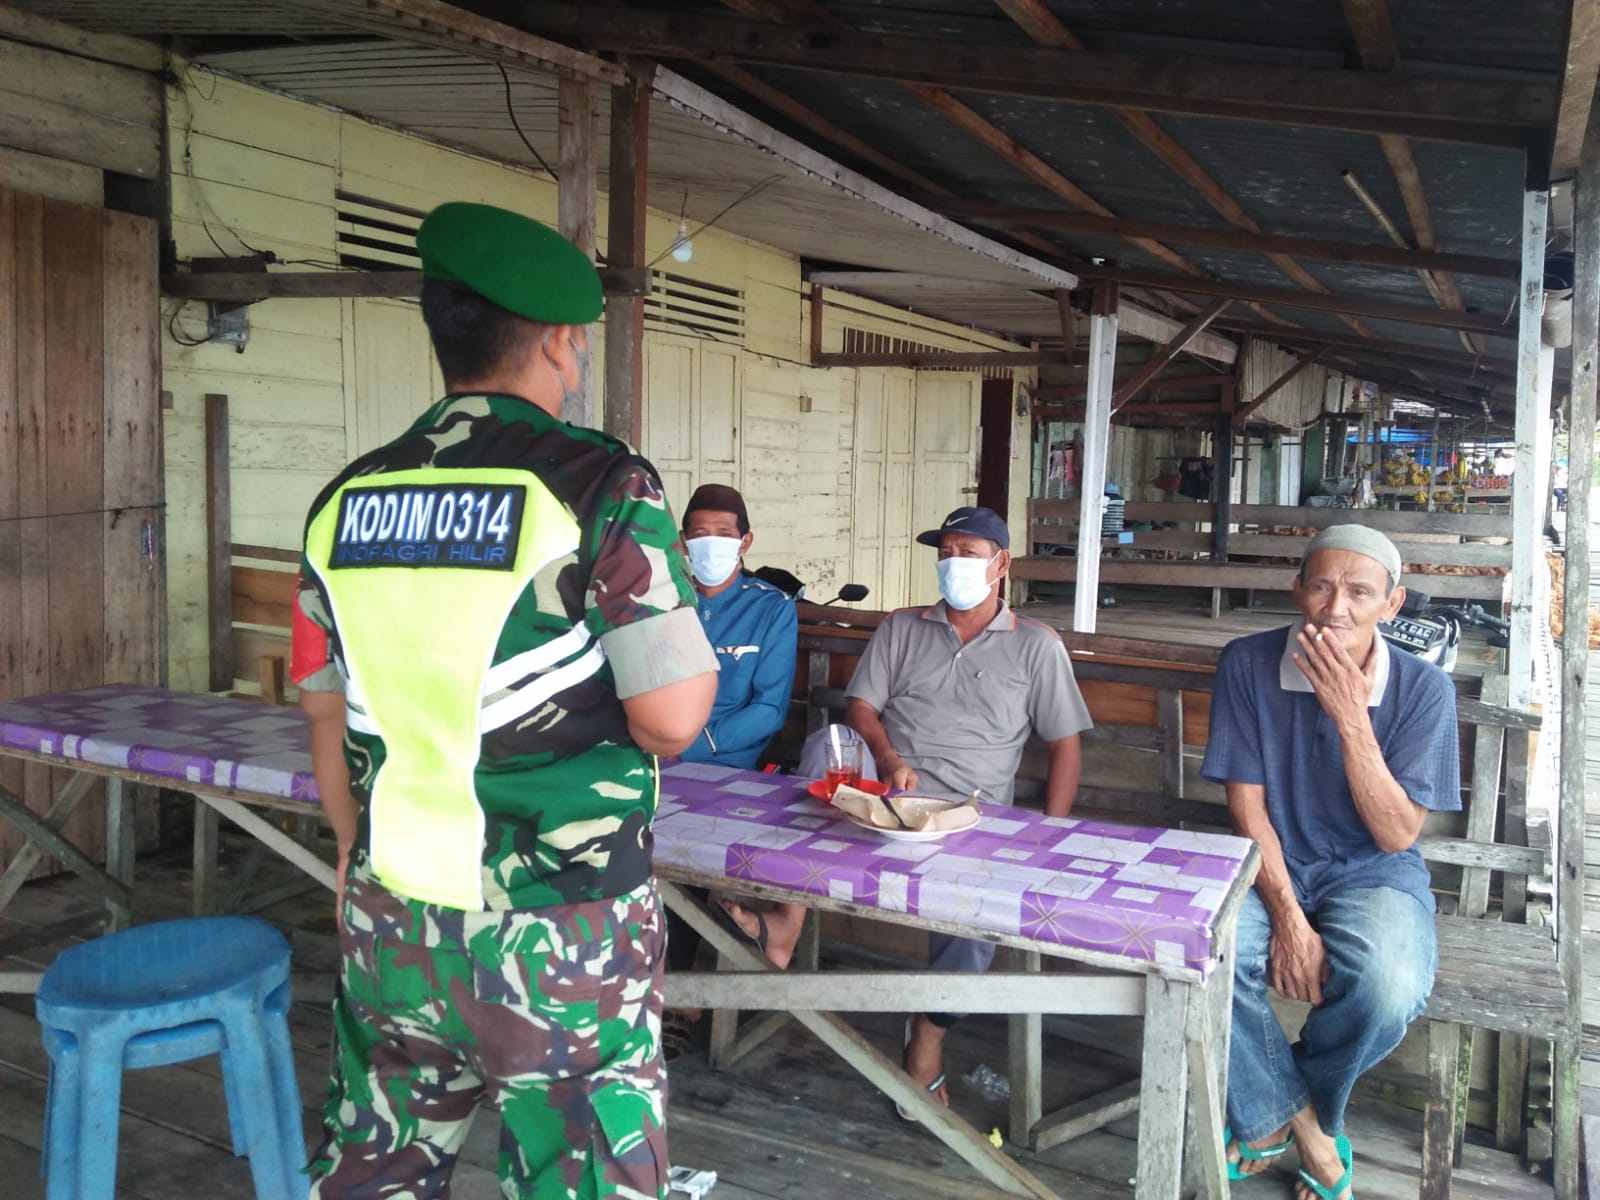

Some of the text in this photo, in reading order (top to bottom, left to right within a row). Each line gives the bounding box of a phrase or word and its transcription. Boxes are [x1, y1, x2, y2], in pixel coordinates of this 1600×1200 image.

[340, 491, 512, 543] KODIM 0314
[449, 545, 507, 563] HILIR
